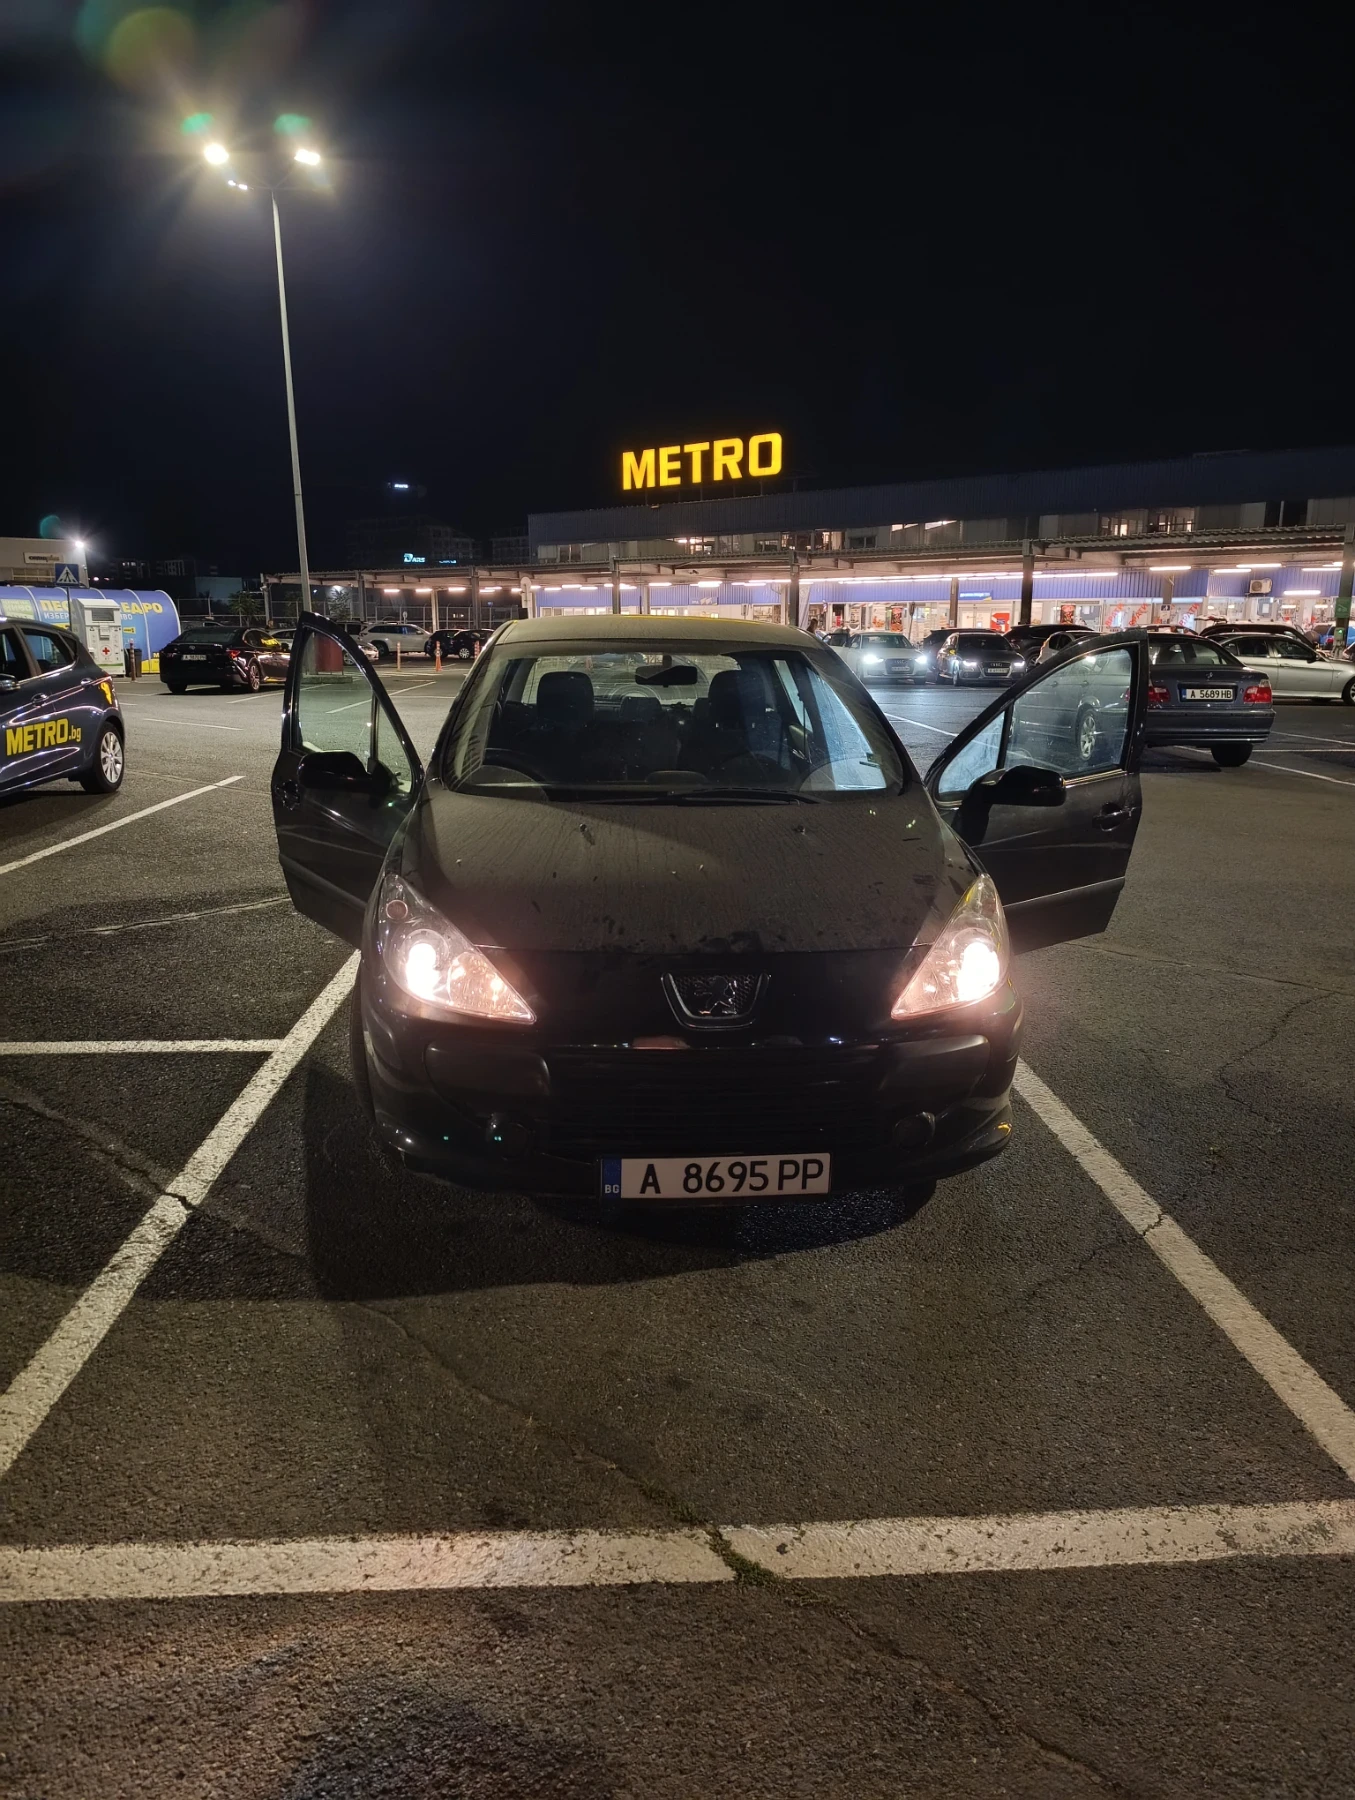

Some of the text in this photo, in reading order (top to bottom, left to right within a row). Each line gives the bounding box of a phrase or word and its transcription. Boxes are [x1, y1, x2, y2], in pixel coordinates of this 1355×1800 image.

[623, 433, 782, 490] METRO
[120, 602, 163, 614] ЕДРО
[1190, 690, 1196, 698] A
[639, 1163, 661, 1194] A
[604, 1184, 620, 1194] BG
